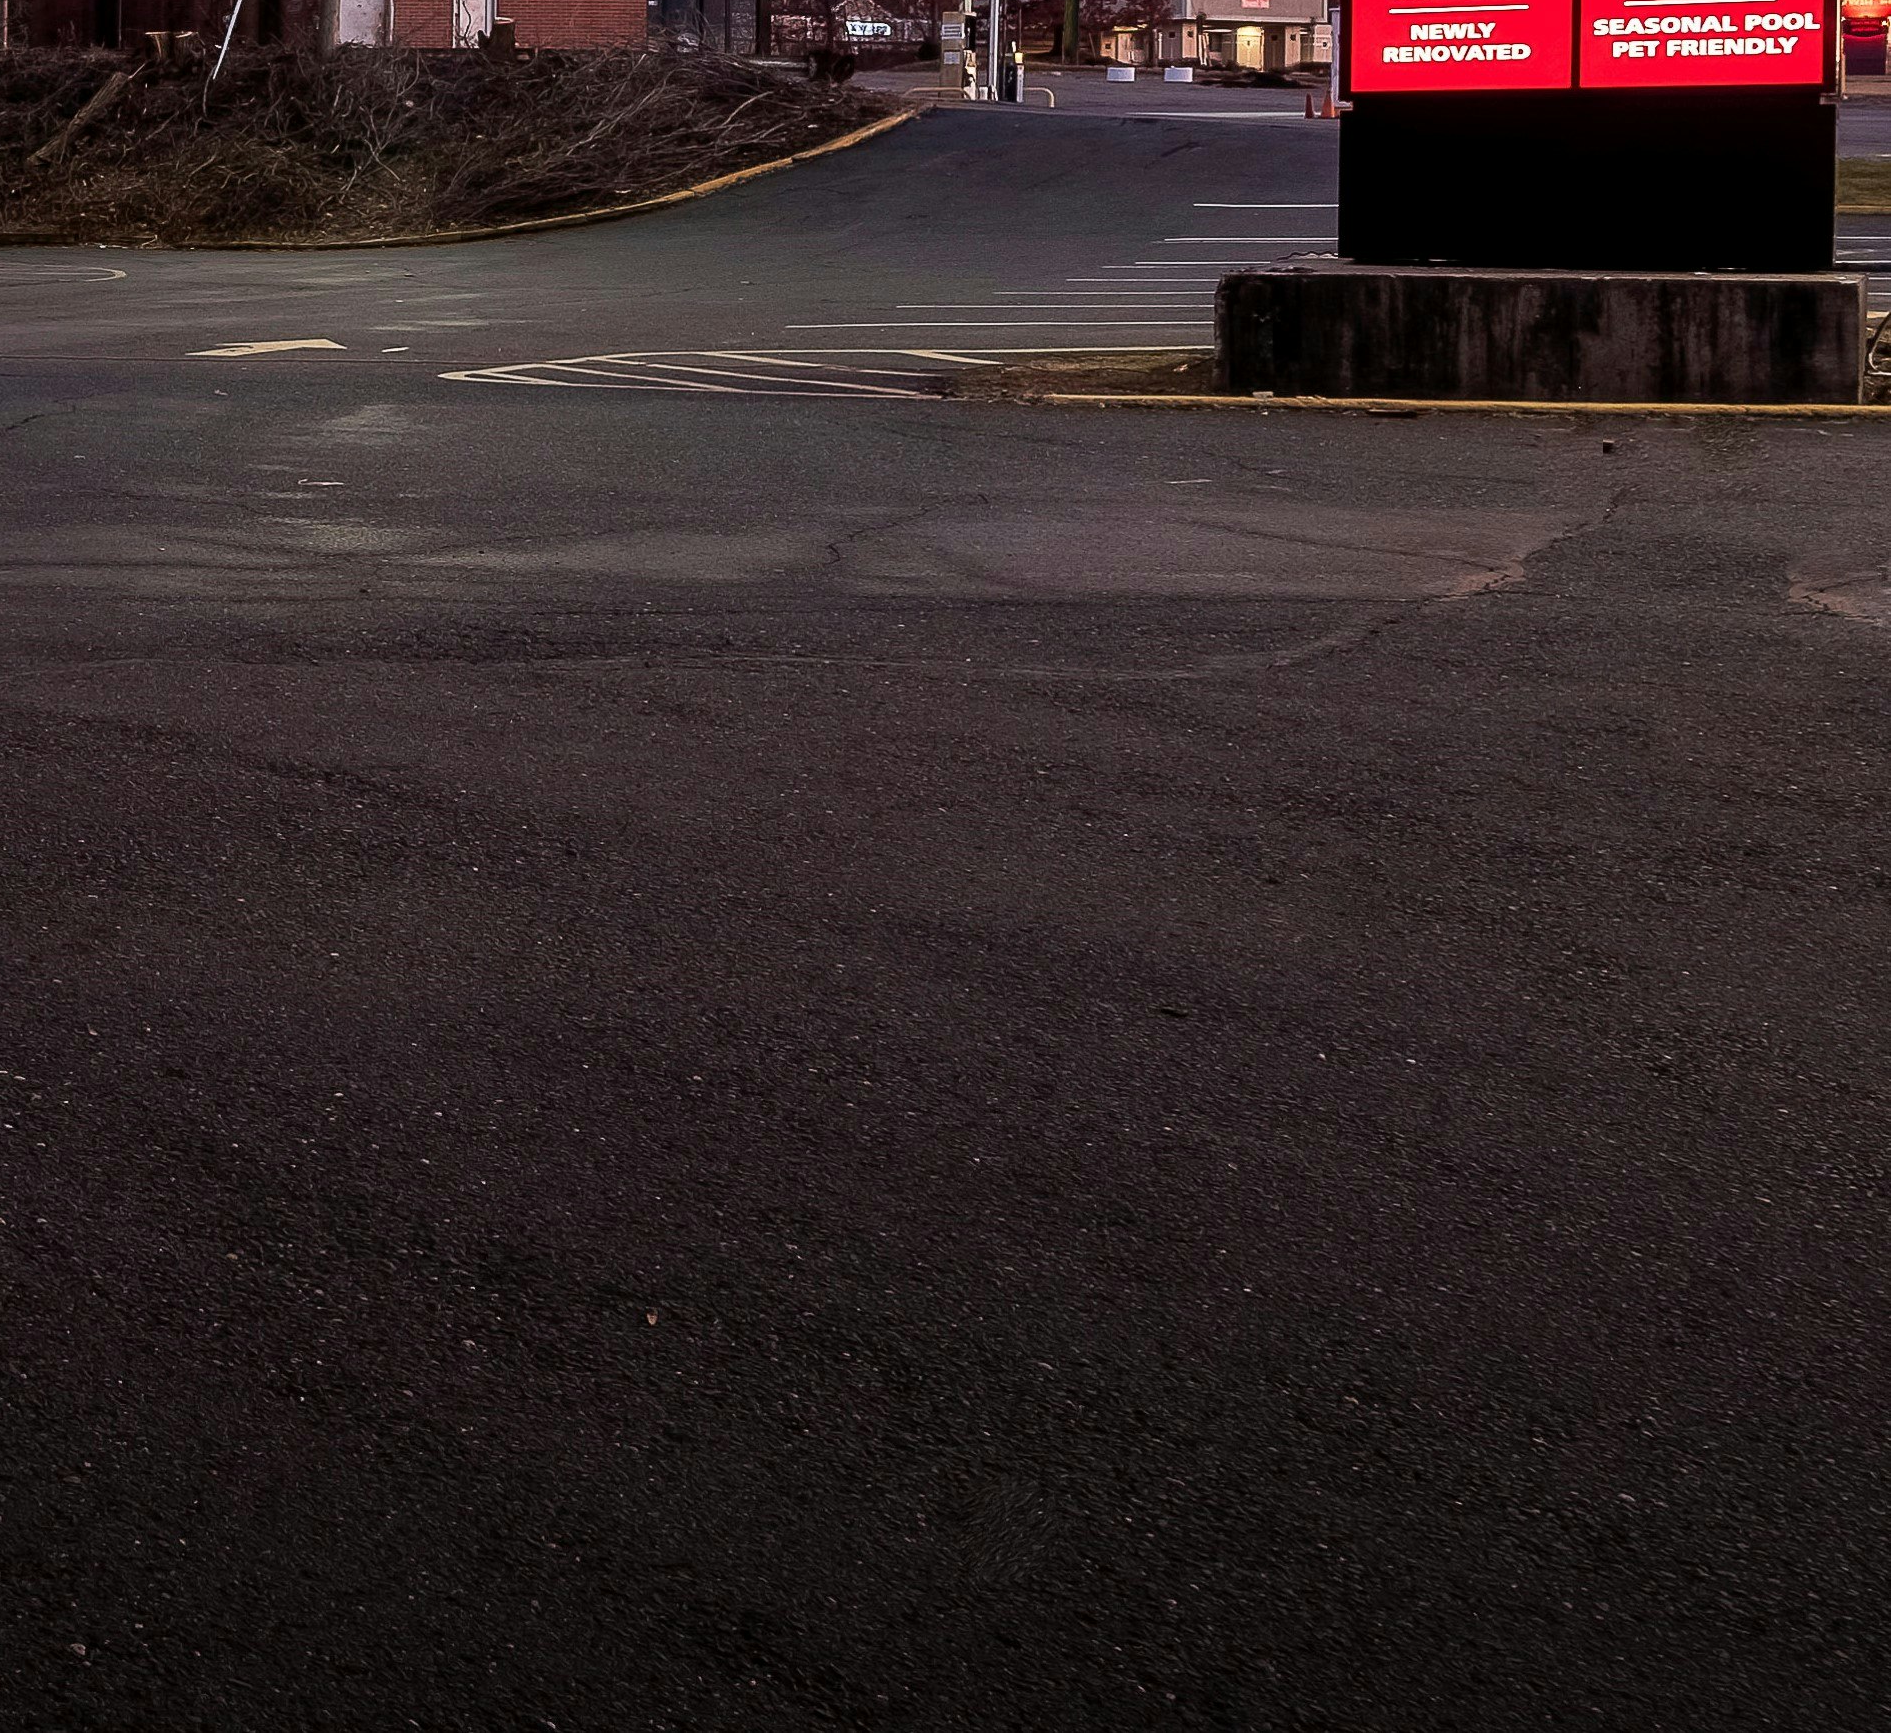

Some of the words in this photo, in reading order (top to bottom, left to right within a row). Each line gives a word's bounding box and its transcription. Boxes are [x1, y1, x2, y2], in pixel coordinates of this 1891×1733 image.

[1410, 22, 1496, 41] NEWLY
[1593, 15, 1739, 36] SEASONAL
[1744, 12, 1821, 32] POOL
[1382, 43, 1532, 63] RENOVATED
[1612, 40, 1661, 58] PET
[1666, 36, 1799, 57] FRIENDLY
